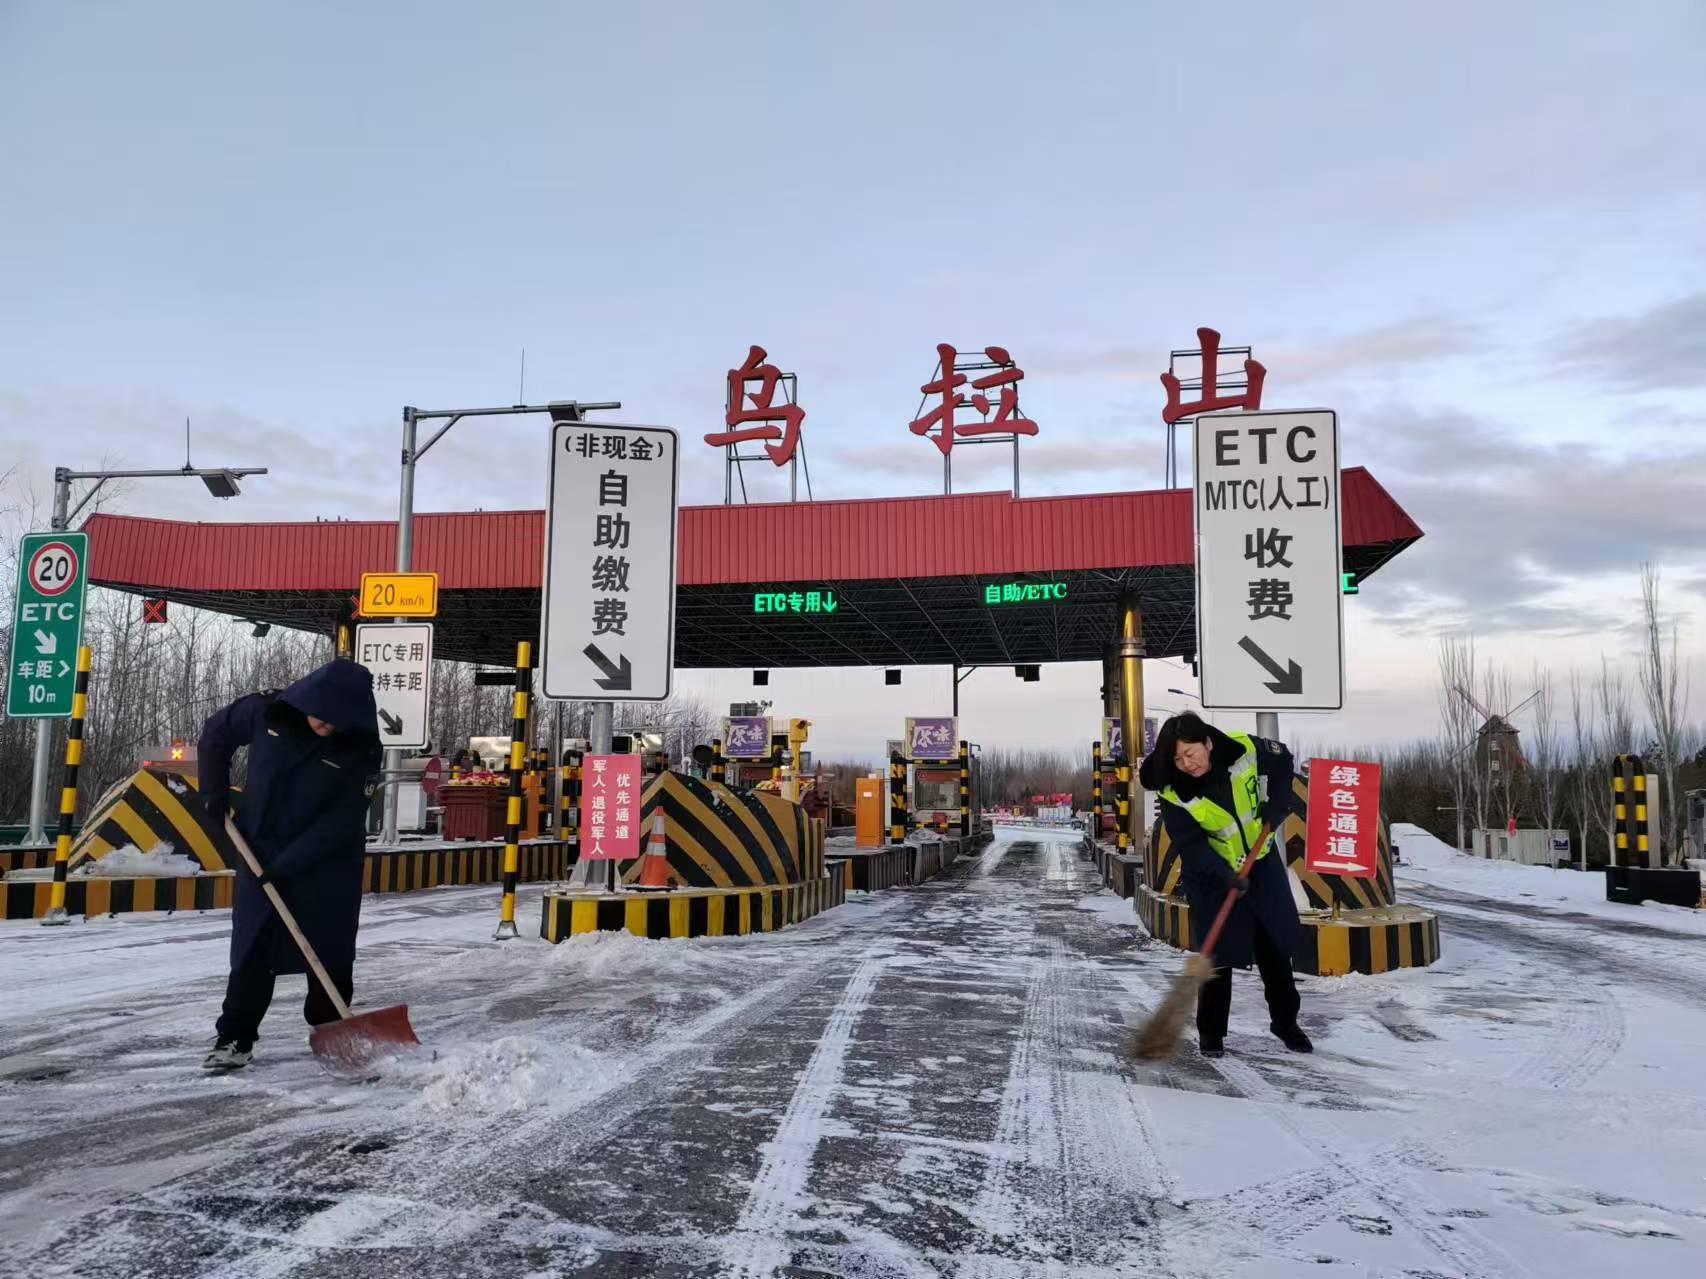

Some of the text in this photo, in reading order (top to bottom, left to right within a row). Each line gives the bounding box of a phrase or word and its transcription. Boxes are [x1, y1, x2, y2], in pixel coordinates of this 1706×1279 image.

[704, 328, 1267, 466] 乌拉山
[564, 433, 664, 461] (非现金)
[1215, 425, 1317, 466] ETC
[1205, 475, 1330, 511] MTC(人工)
[592, 469, 630, 636] 自助缴费
[39, 556, 69, 581] 20
[1244, 527, 1293, 620] 收费
[372, 583, 424, 607] 20 km/h
[754, 591, 820, 612] ETC专用
[985, 583, 1067, 604] 自助/ETC
[21, 602, 75, 622] ETC
[363, 642, 424, 662] ETC专用
[17, 660, 53, 679] 车距
[371, 671, 423, 691] 持车距
[28, 684, 56, 703] 10m
[615, 773, 631, 839] 优先通道
[1326, 765, 1360, 858] 绿色通道
